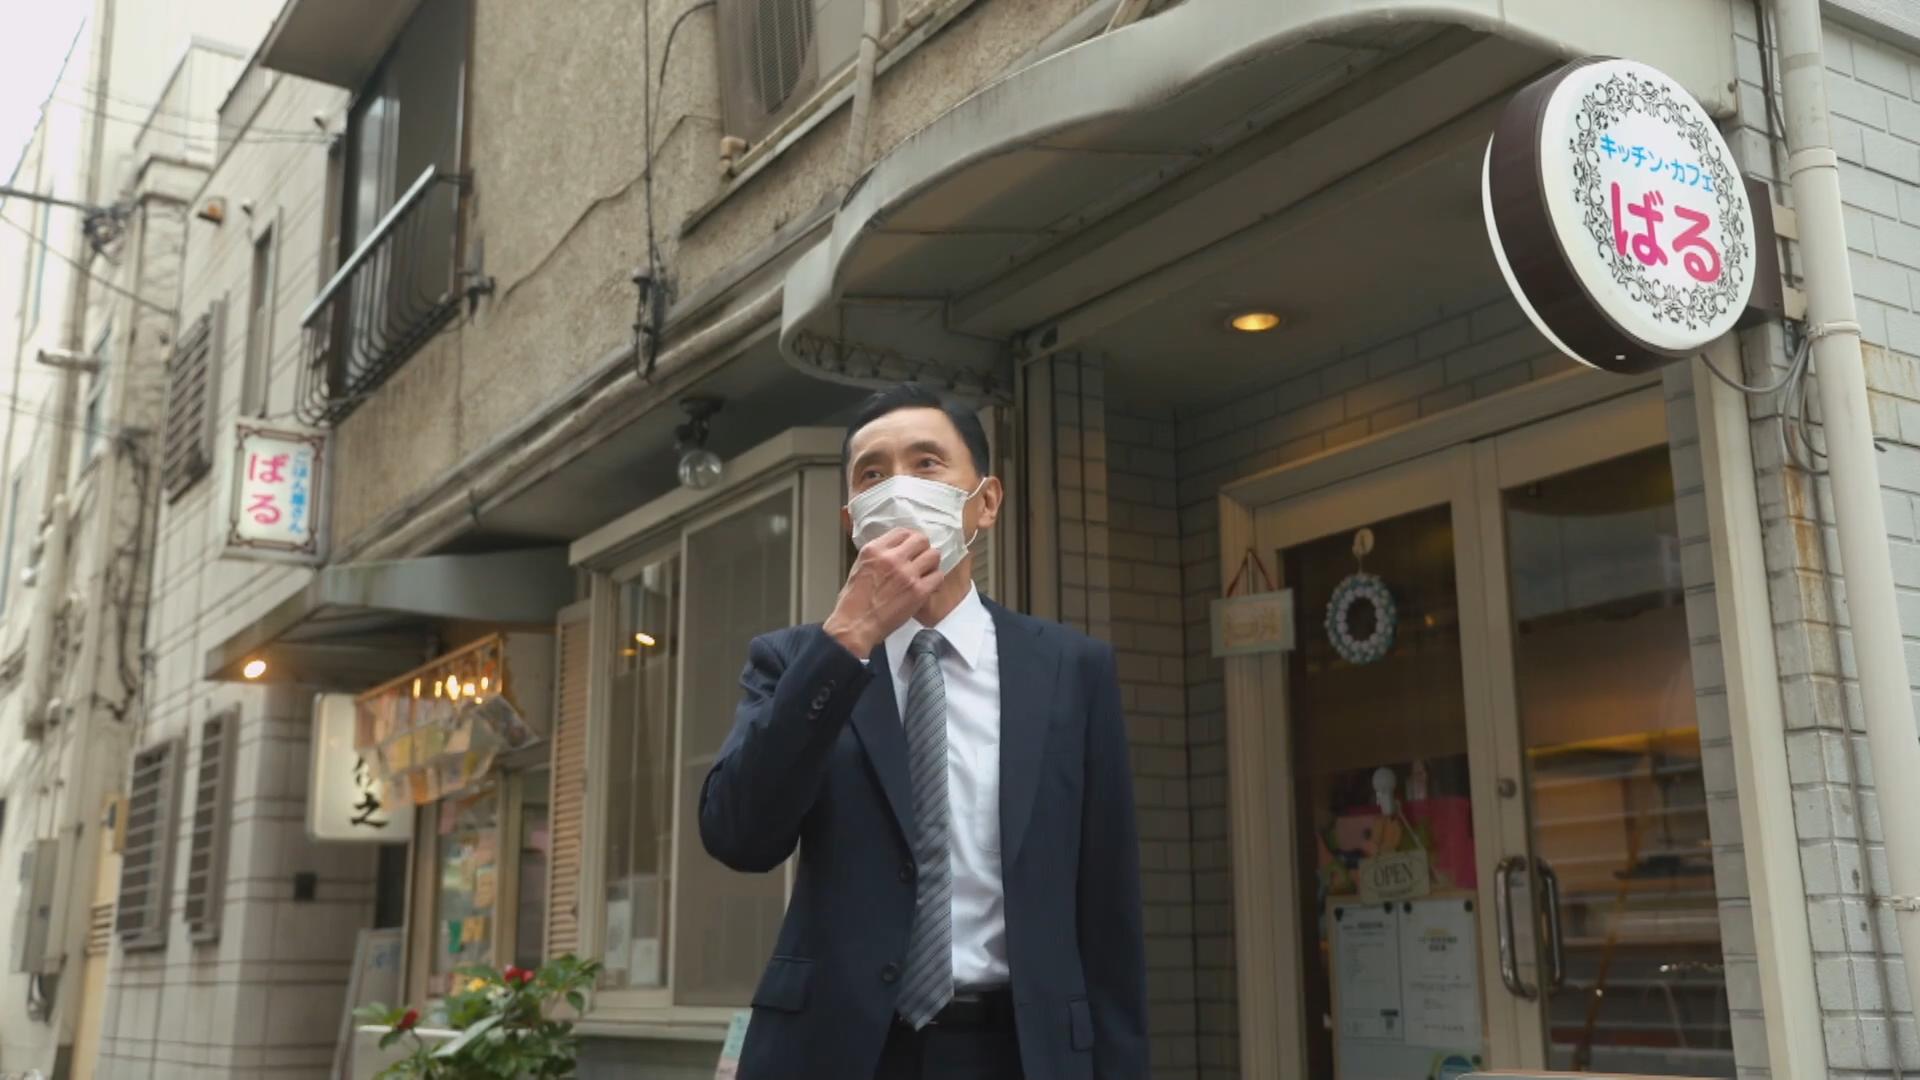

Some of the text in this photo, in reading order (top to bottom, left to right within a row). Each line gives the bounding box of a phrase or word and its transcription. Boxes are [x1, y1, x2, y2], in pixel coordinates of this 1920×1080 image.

[1611, 181, 1722, 283] ばる
[247, 453, 289, 525] ばる
[1372, 862, 1415, 888] OPEN
